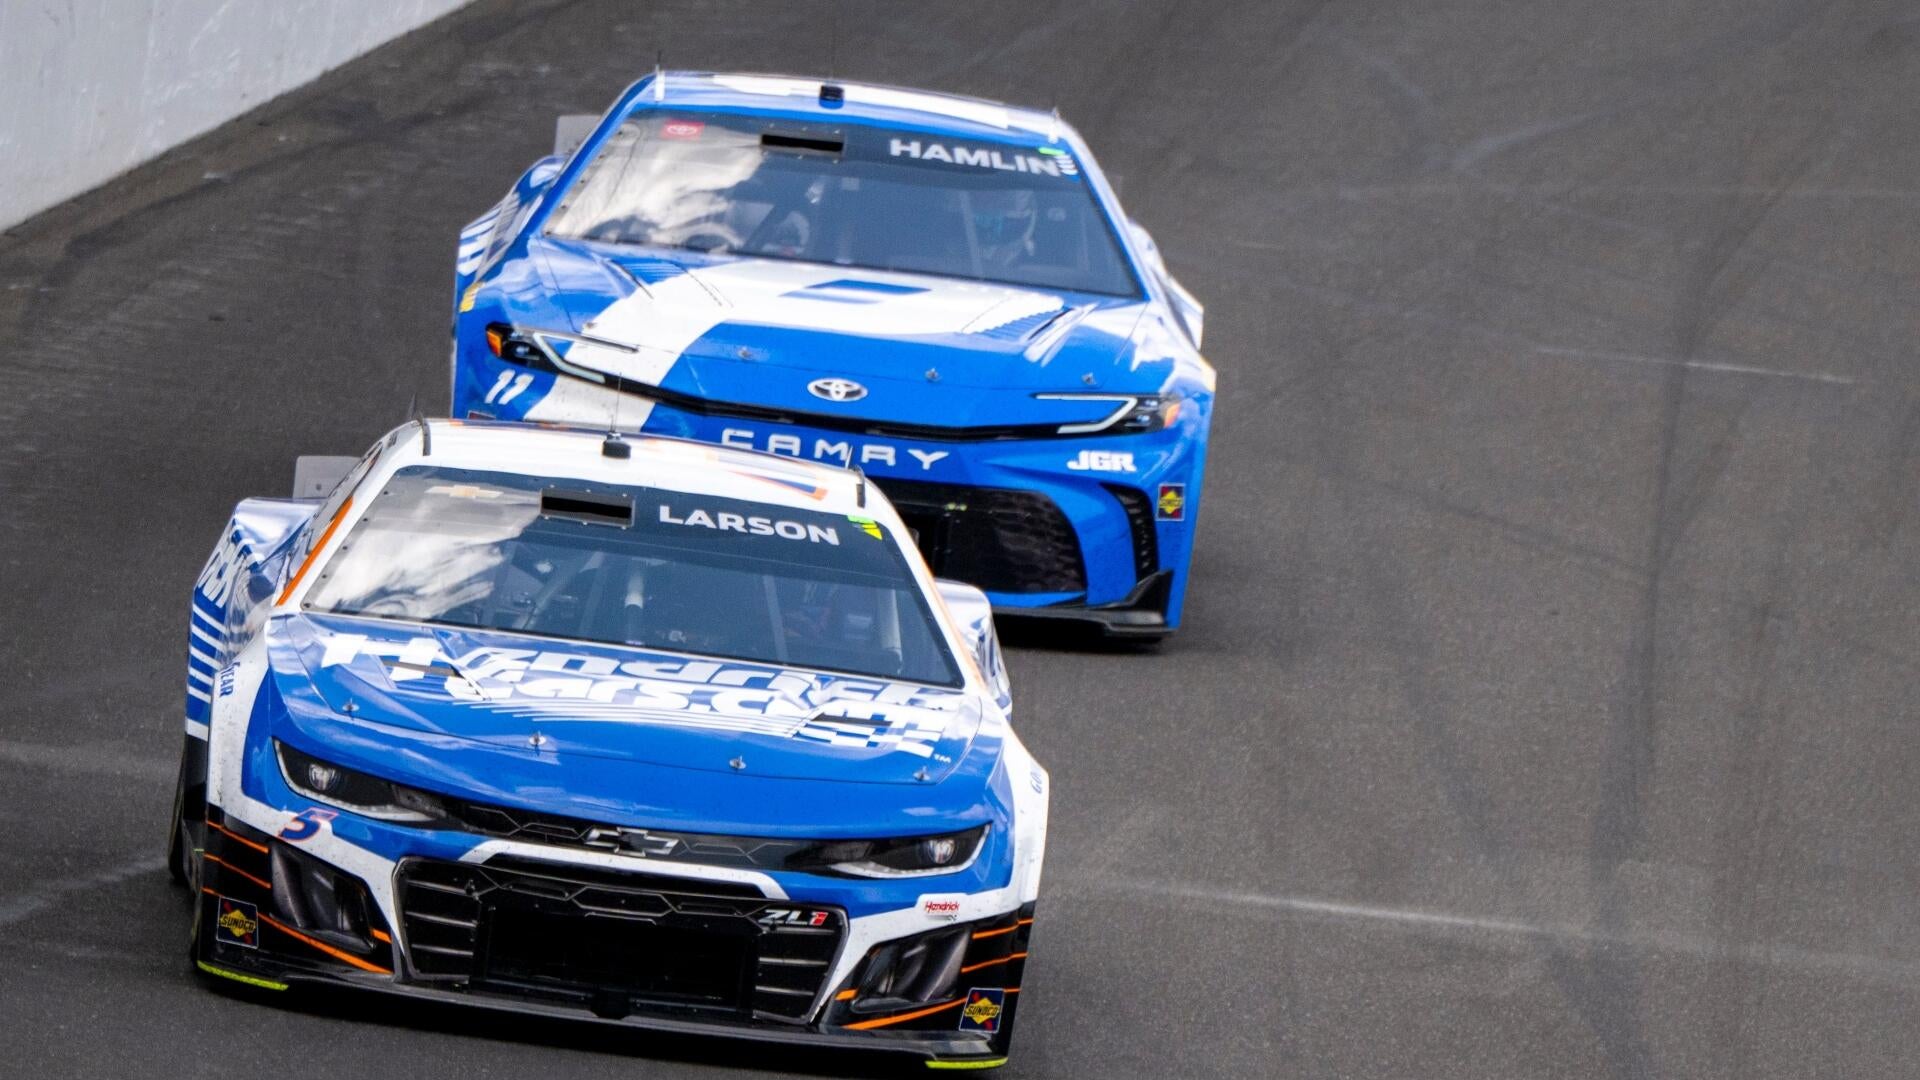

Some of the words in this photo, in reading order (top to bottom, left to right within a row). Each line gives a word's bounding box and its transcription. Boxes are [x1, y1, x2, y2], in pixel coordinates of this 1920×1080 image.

[889, 138, 1061, 177] HAMLIN
[485, 369, 534, 405] 11
[721, 428, 949, 470] CAMRY
[1066, 450, 1137, 473] JGR
[659, 504, 840, 546] LARSON
[277, 807, 339, 841] 5
[221, 915, 256, 931] SUNOCO
[758, 909, 829, 926] ZL1
[965, 1004, 999, 1017] SUNOCO
